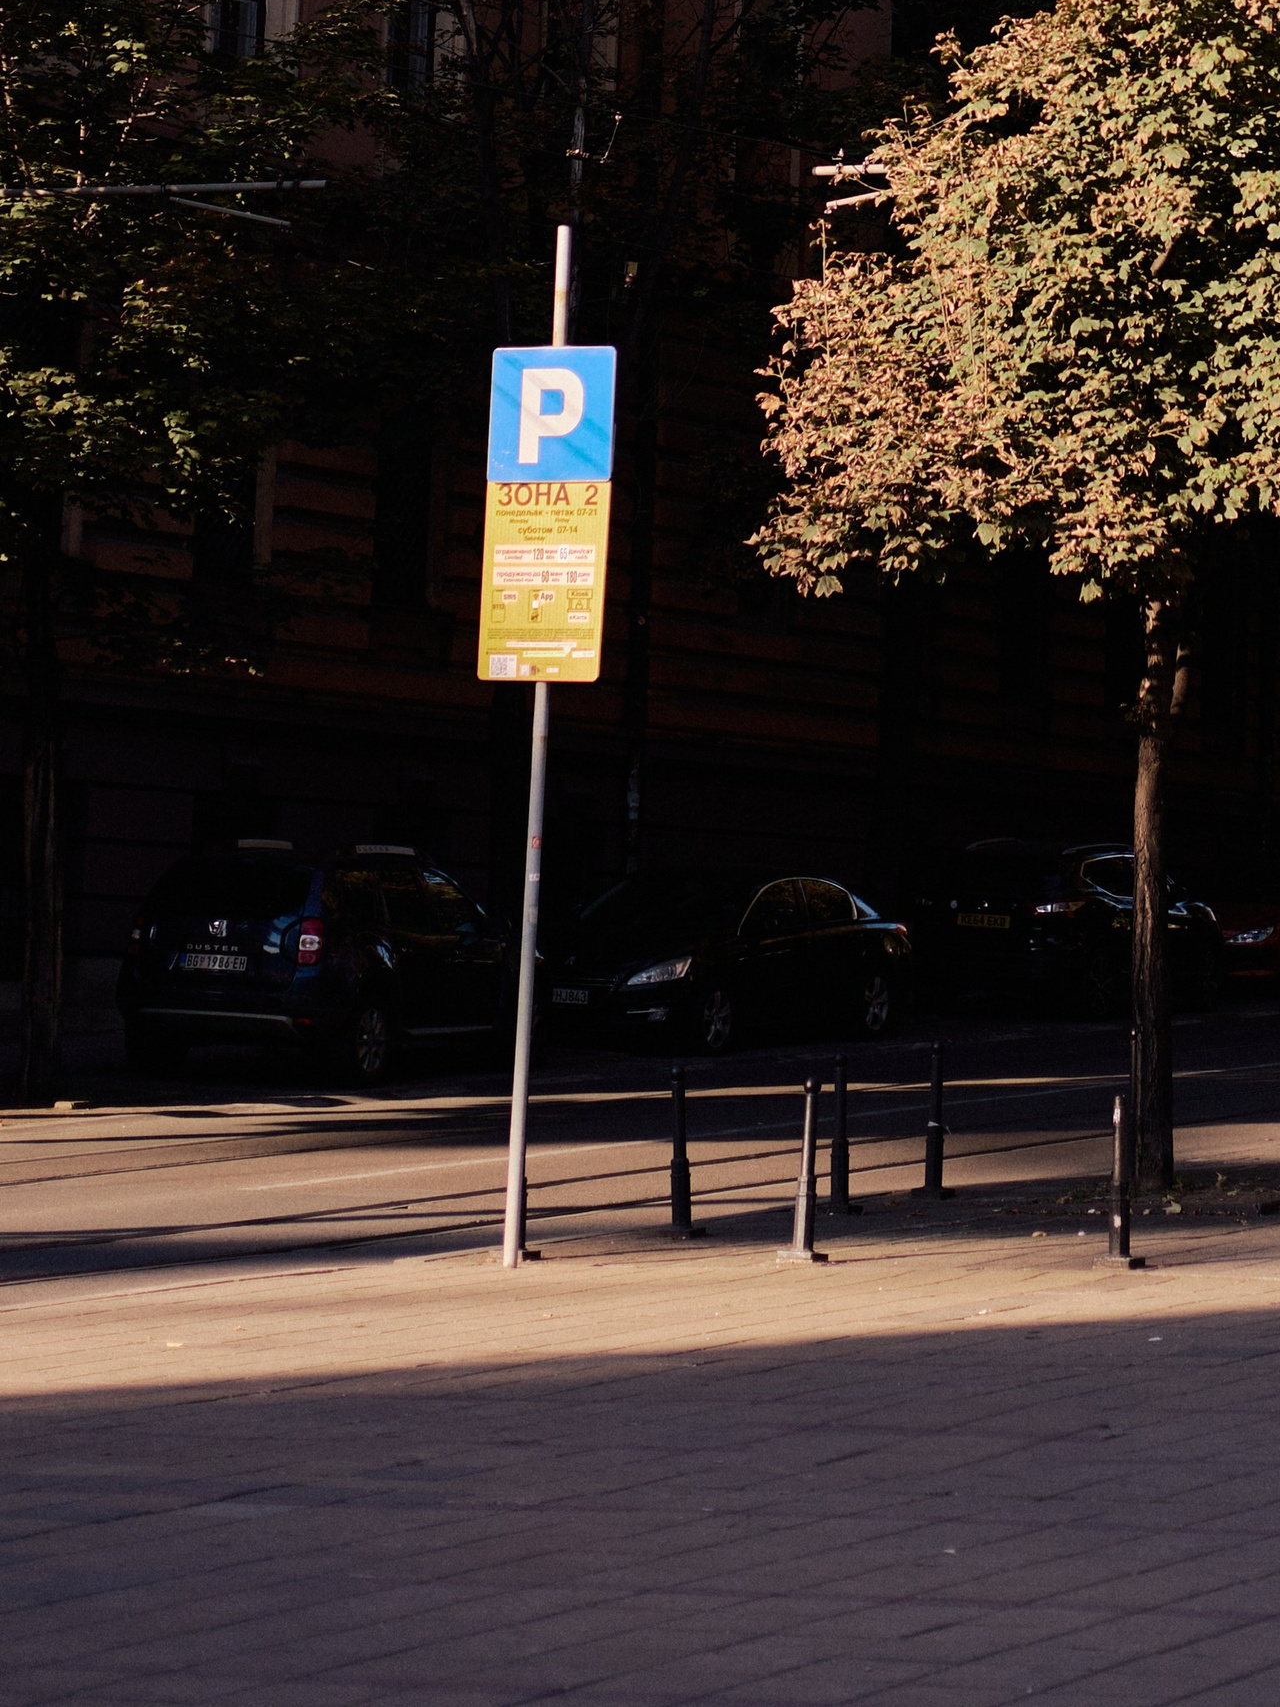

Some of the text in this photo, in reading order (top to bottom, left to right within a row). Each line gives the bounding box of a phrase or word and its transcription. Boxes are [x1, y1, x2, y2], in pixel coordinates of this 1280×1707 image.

[518, 368, 584, 464] P
[498, 483, 598, 506] ЗОНА 2
[576, 508, 598, 516] 07-21
[518, 526, 578, 535] суботом 07-14
[533, 548, 544, 560] 120
[541, 570, 550, 583] 60
[566, 571, 578, 583] 180
[540, 592, 554, 601] App
[186, 943, 239, 952] DUSTER
